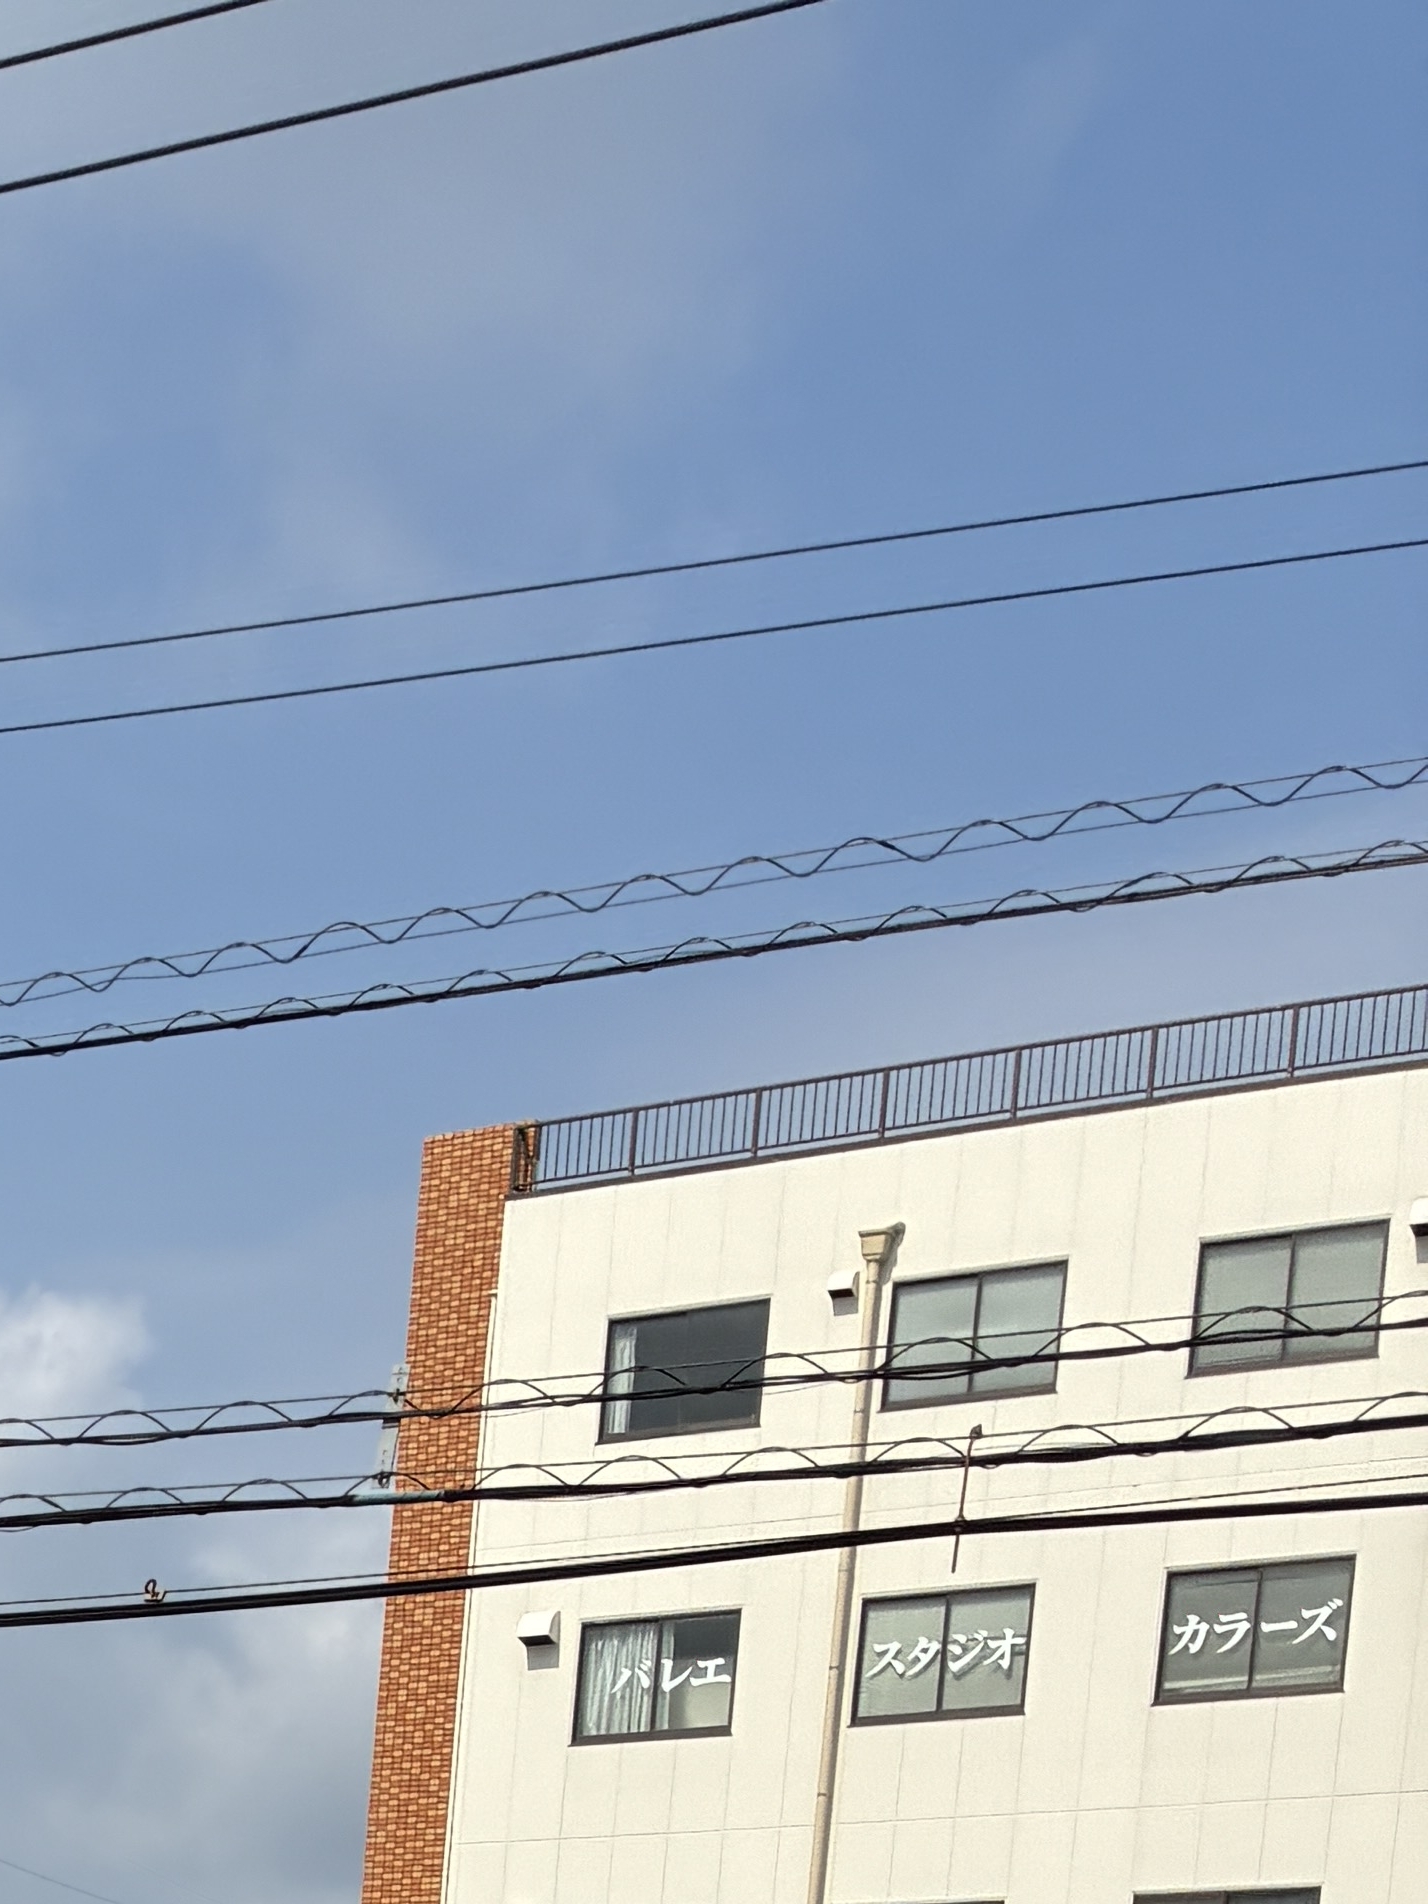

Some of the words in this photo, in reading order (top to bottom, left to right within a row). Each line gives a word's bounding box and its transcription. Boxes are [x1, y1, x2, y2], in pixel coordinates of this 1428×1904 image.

[609, 1655, 732, 1694] バレエ
[864, 1626, 1029, 1681] スタジオ
[1168, 1598, 1345, 1656] カラーズ
